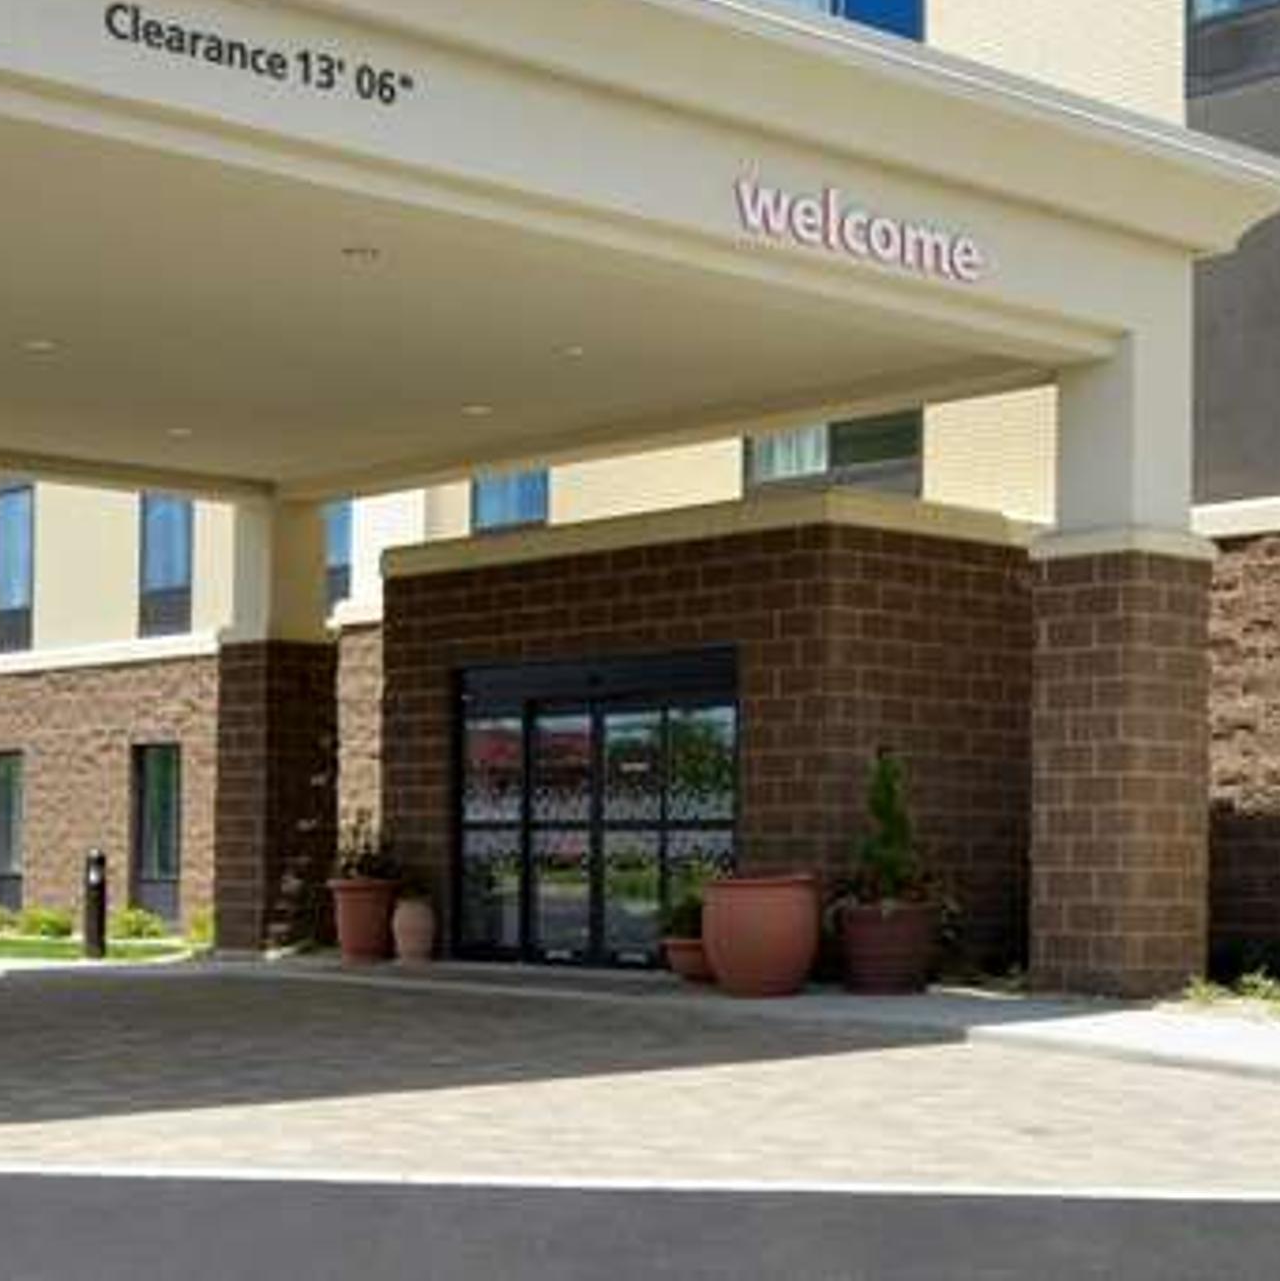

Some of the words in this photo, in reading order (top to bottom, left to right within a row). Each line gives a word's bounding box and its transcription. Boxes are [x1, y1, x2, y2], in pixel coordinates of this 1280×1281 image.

[105, 2, 289, 80] Clearance
[296, 49, 347, 89] 13'
[734, 178, 983, 283] welcome
